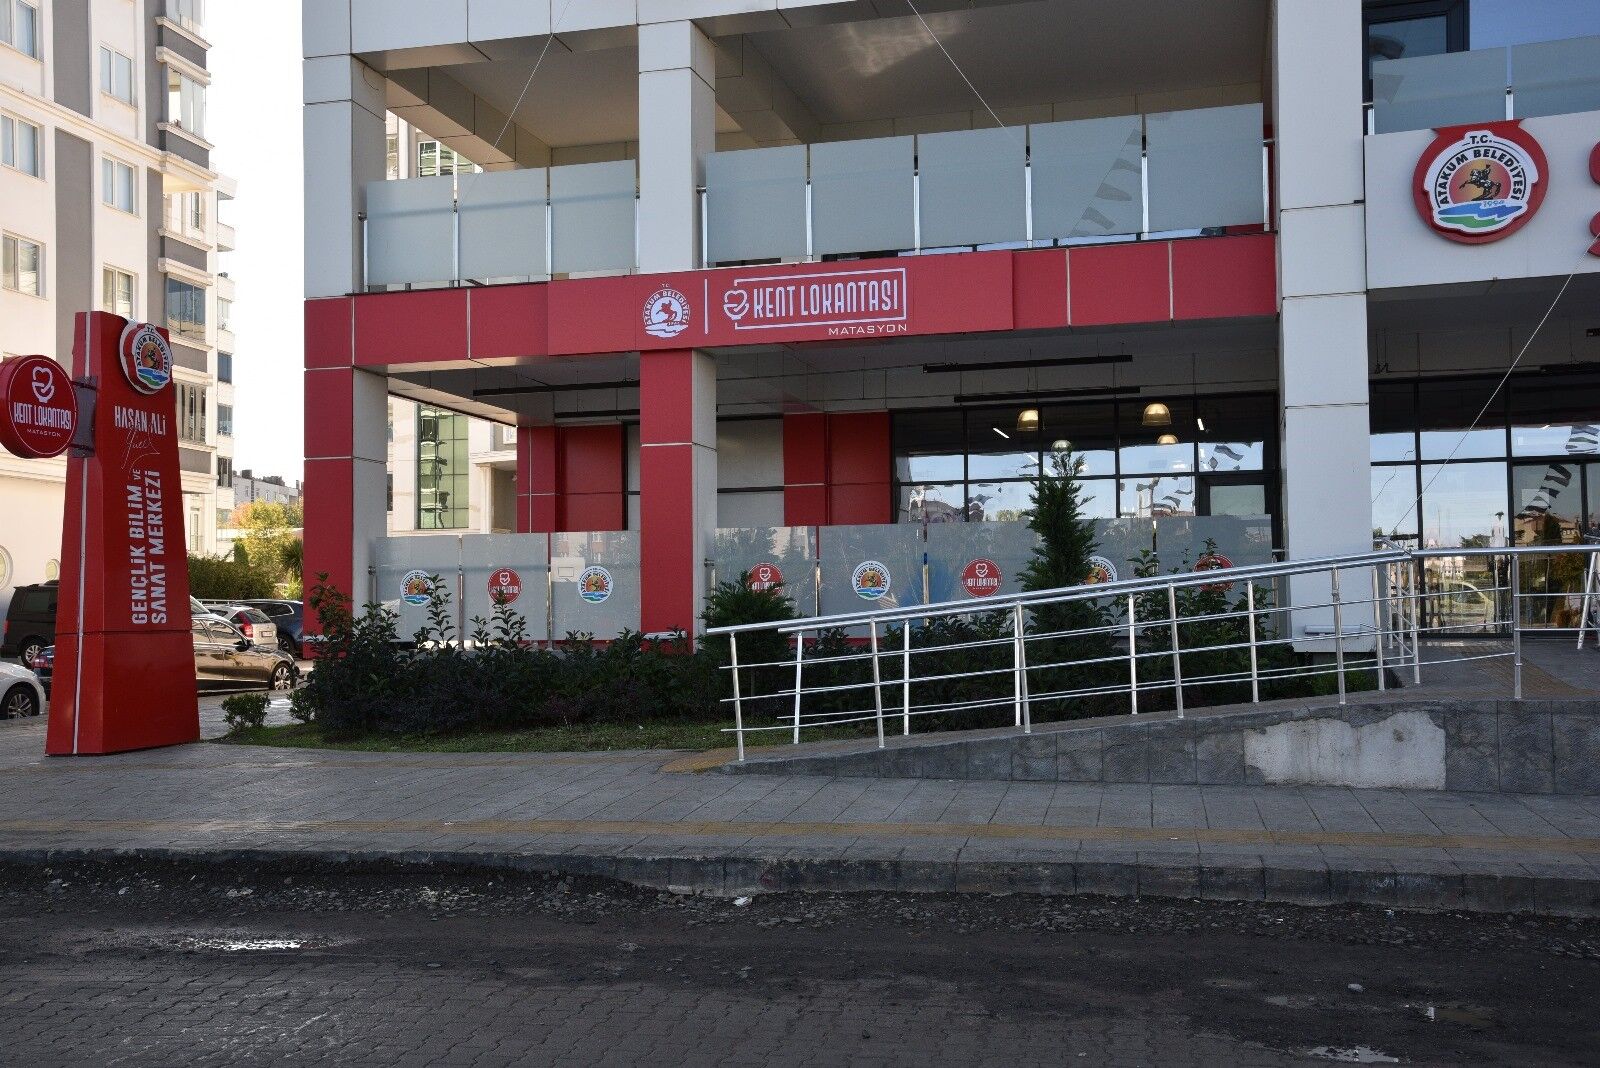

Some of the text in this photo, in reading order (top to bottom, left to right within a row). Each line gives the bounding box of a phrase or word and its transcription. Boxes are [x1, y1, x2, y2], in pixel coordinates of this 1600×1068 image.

[1469, 134, 1493, 145] T.C.
[1438, 148, 1524, 205] ATAKUM BELEDİYESİ
[644, 293, 661, 325] ATAKUM
[753, 279, 898, 319] KENT LOKANTASI
[828, 323, 908, 336] MATASYON
[135, 336, 148, 367] ATAKUM
[13, 401, 72, 430] KENT LOKANTASI
[114, 405, 166, 436] HASAN ALİ
[27, 428, 61, 437] MATASYON
[126, 468, 149, 625] GENÇLİK BİLİM VE
[144, 470, 168, 625] SANAT MERKEZİ
